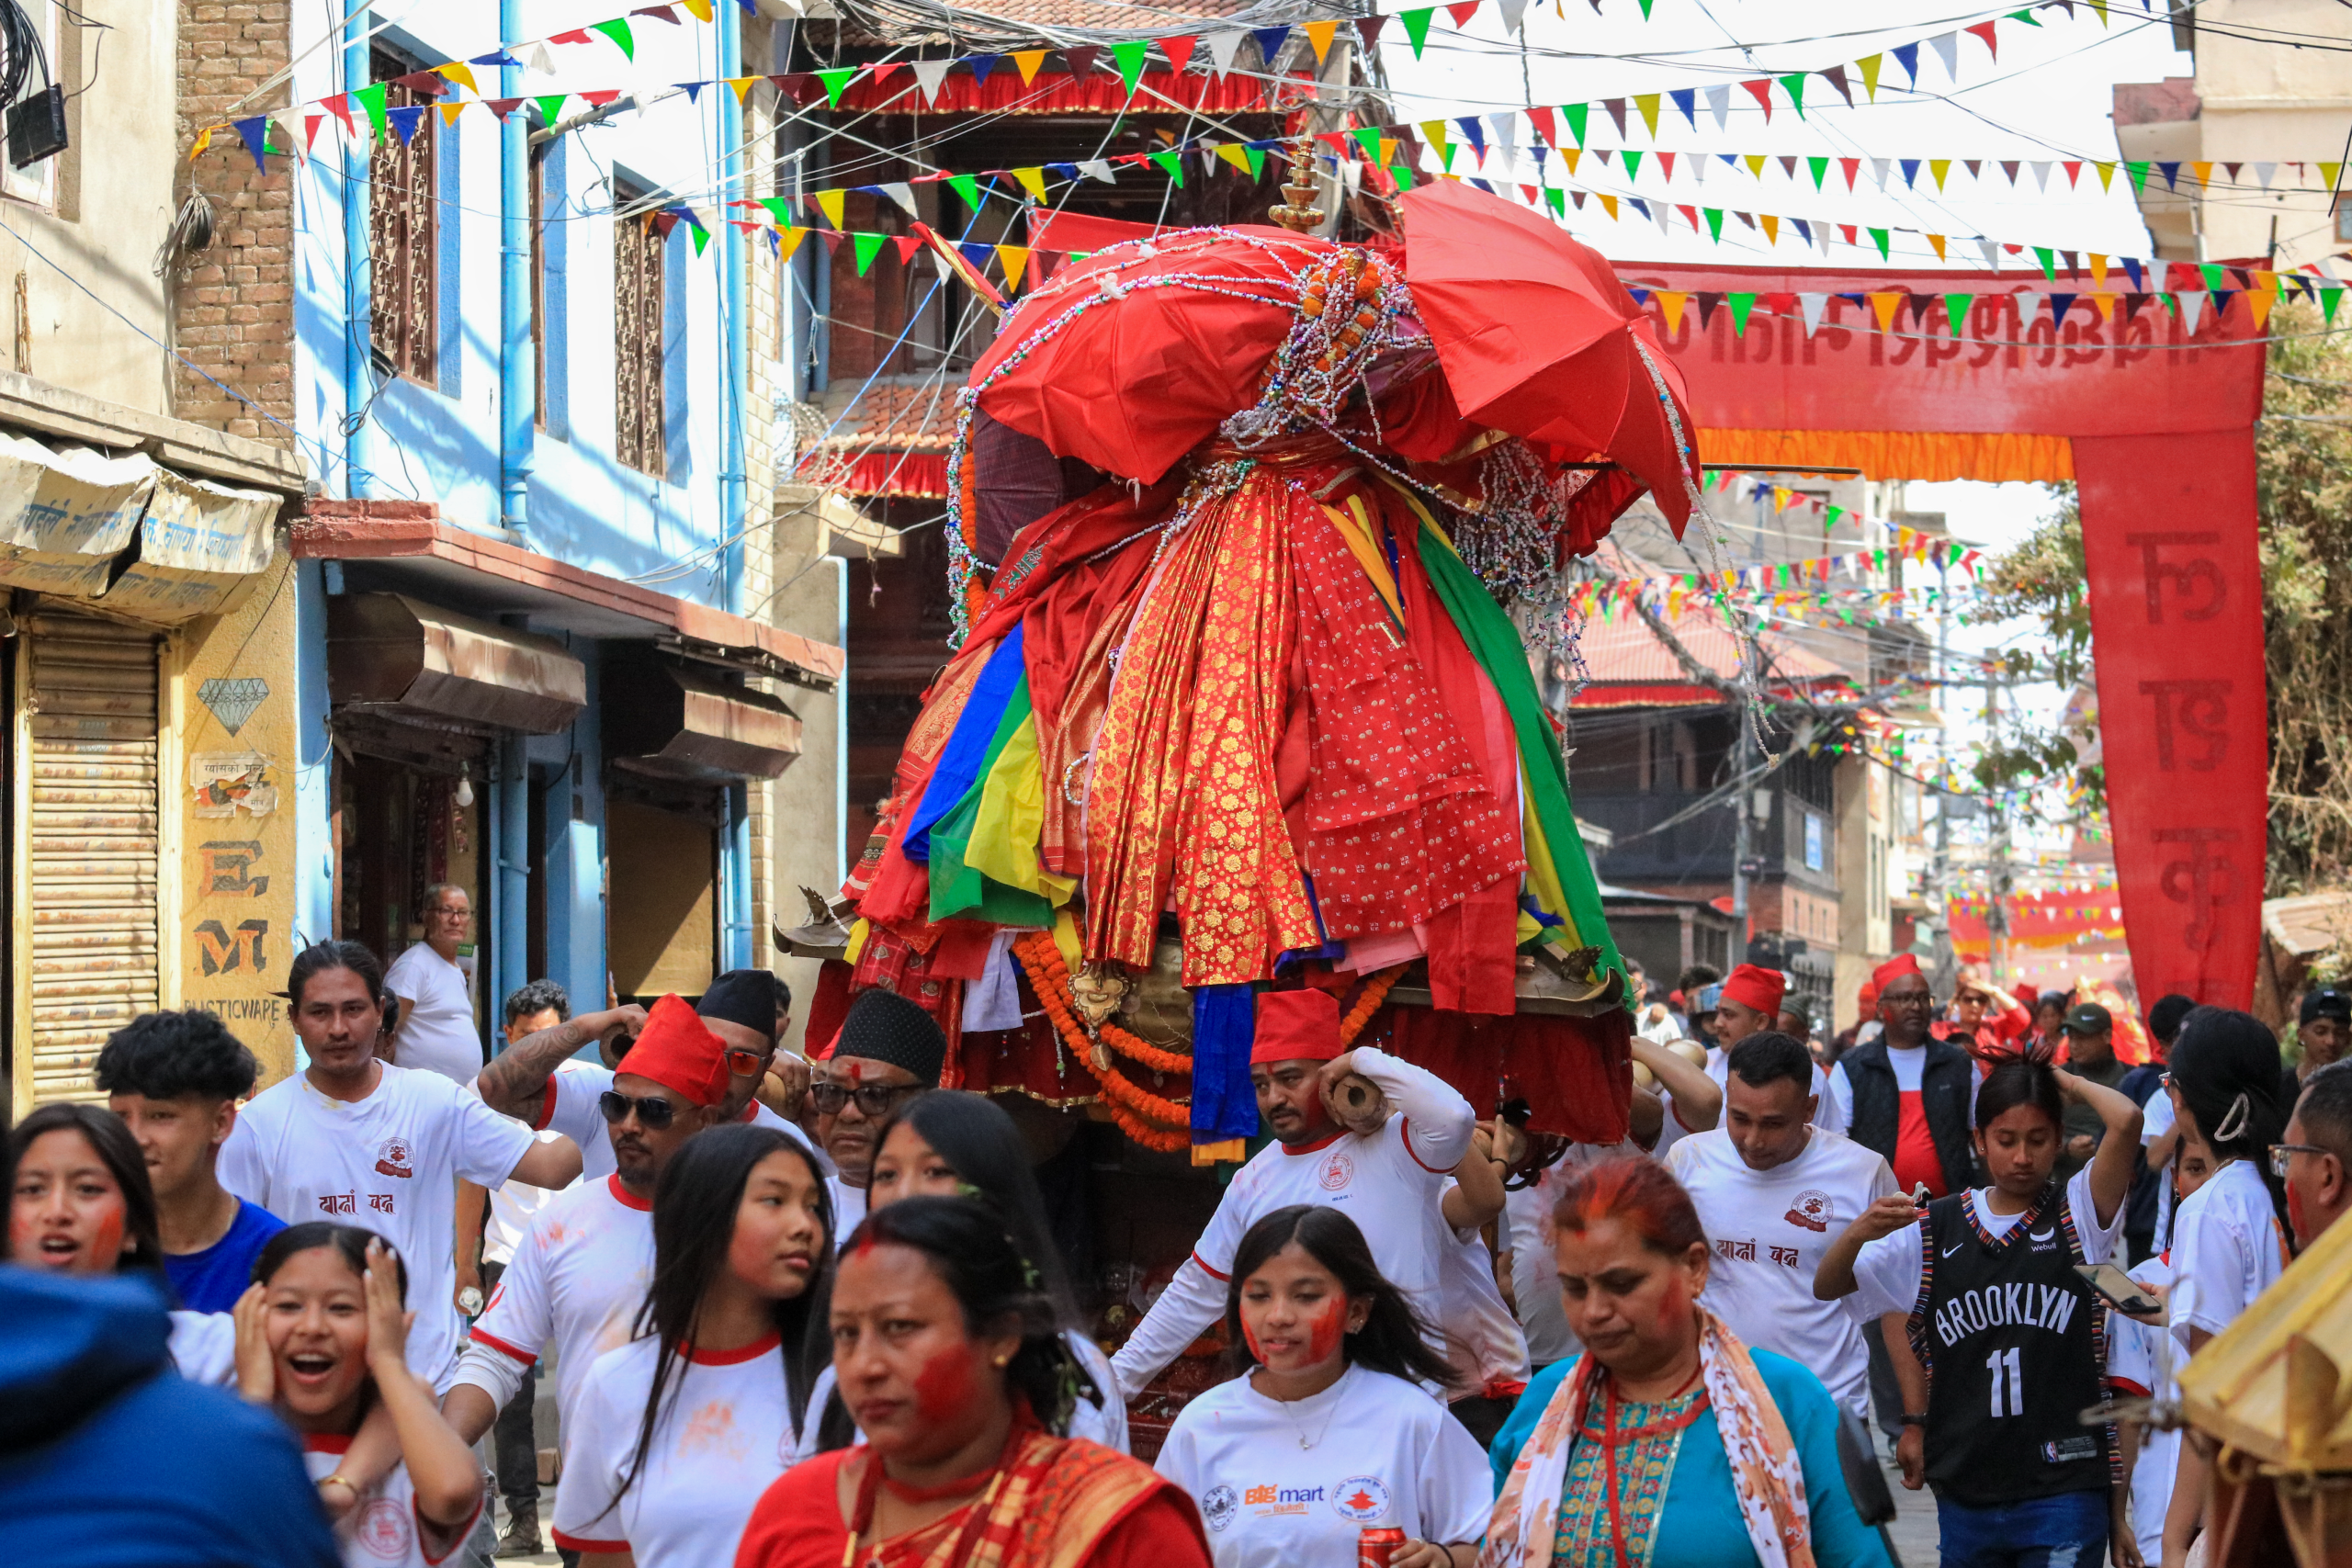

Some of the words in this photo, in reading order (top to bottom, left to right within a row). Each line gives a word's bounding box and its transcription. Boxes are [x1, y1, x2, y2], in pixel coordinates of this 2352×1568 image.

[2030, 1242, 2057, 1252] Webull
[1935, 1282, 2077, 1348] BROOKLYN
[1986, 1347, 2023, 1417] 11
[1280, 1485, 1324, 1503] mart
